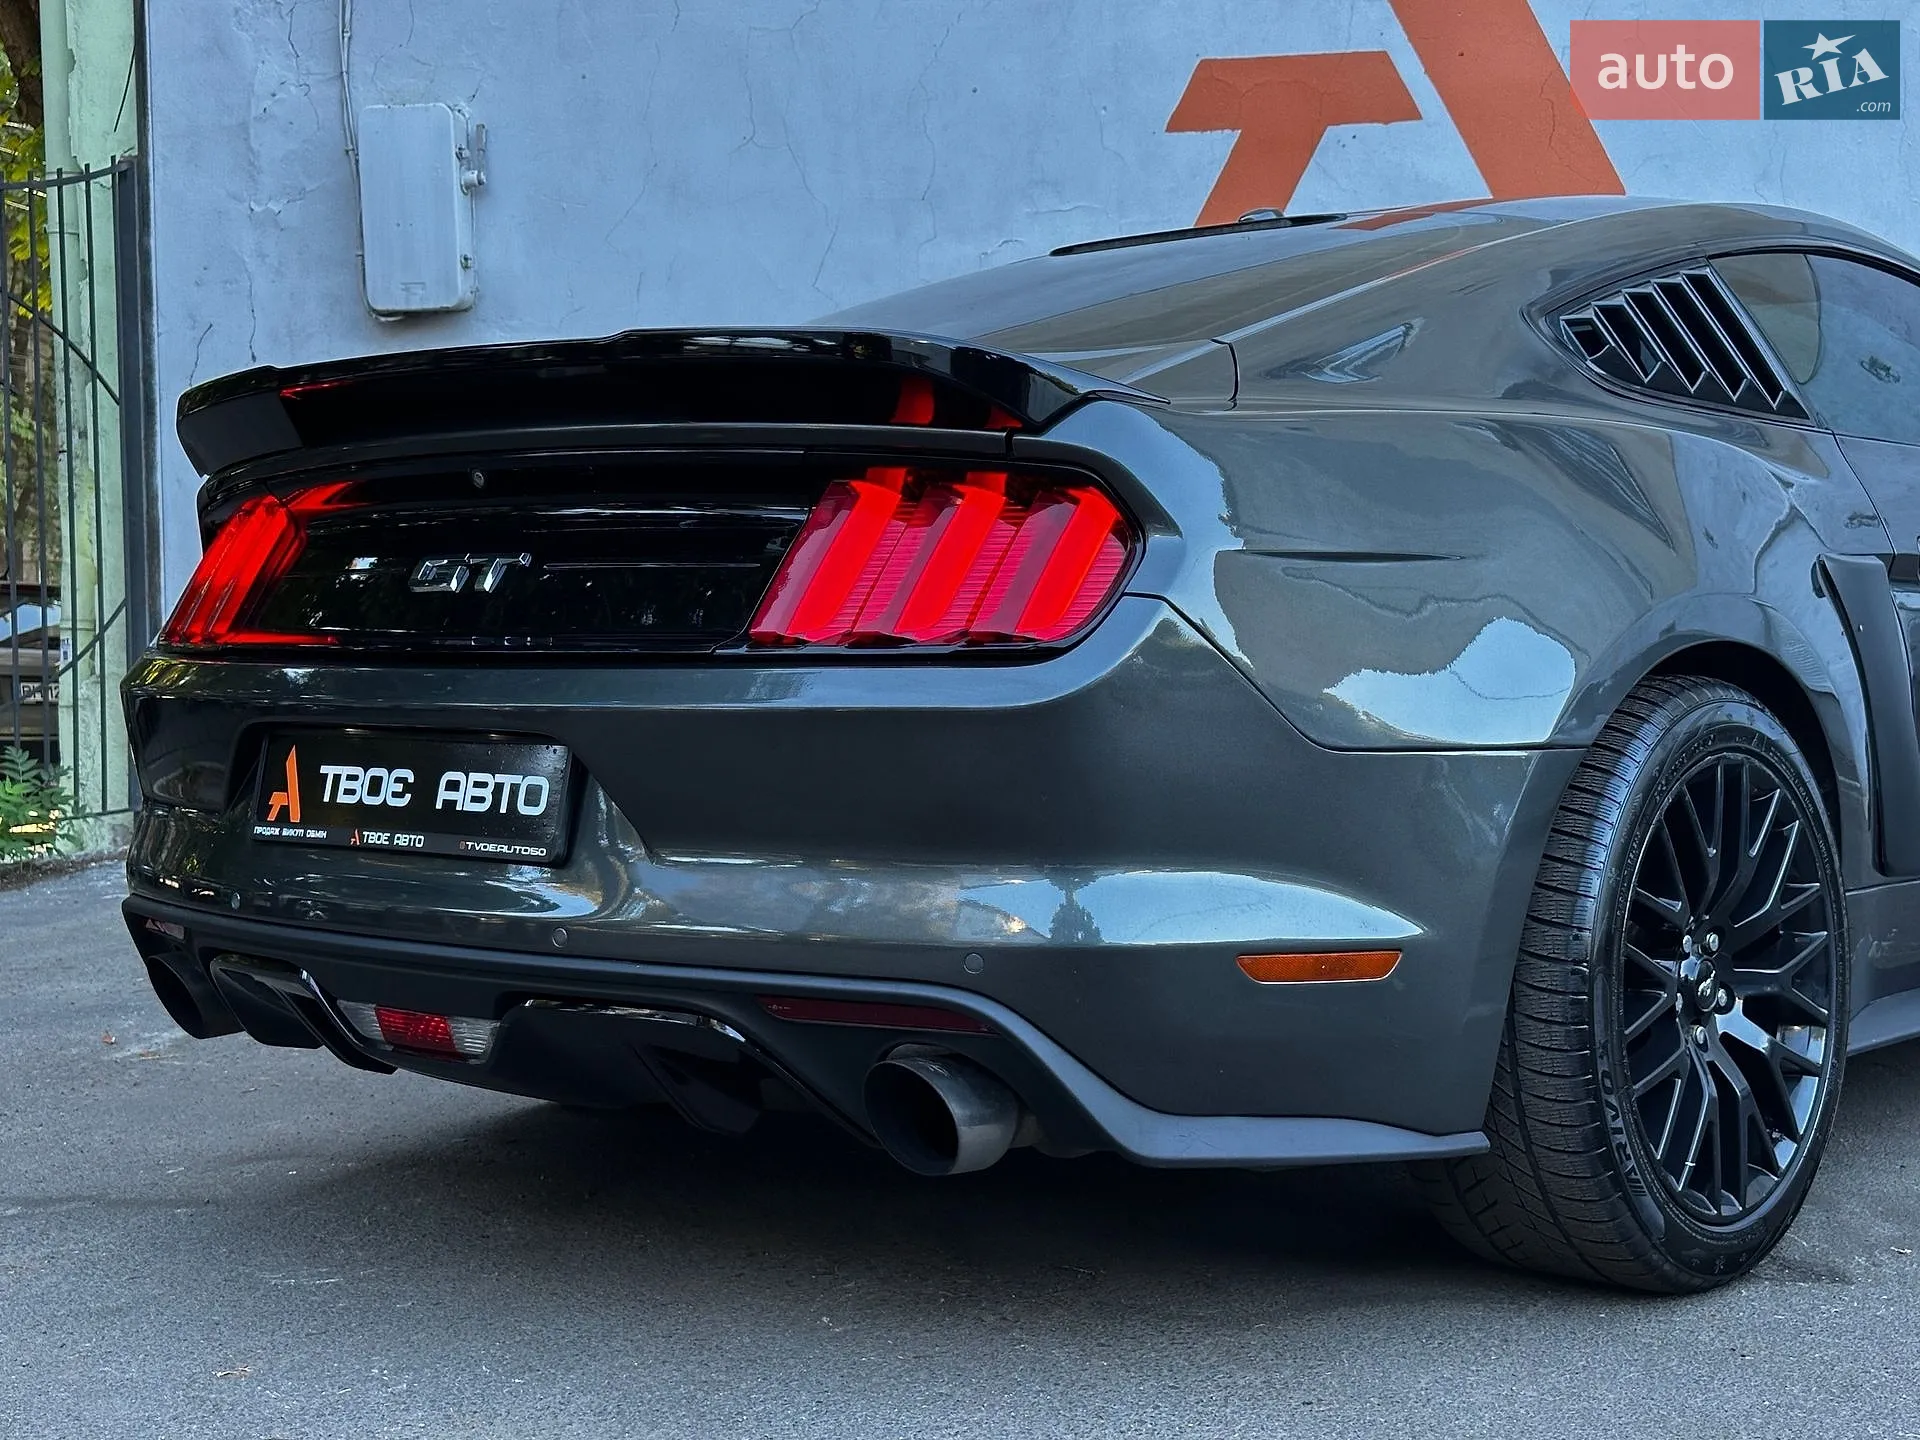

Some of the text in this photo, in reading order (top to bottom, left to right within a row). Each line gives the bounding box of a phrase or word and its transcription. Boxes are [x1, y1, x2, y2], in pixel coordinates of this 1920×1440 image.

[408, 553, 532, 593] GT
[319, 765, 550, 816] ТВОЄ АВТО
[393, 833, 425, 848] АВТО
